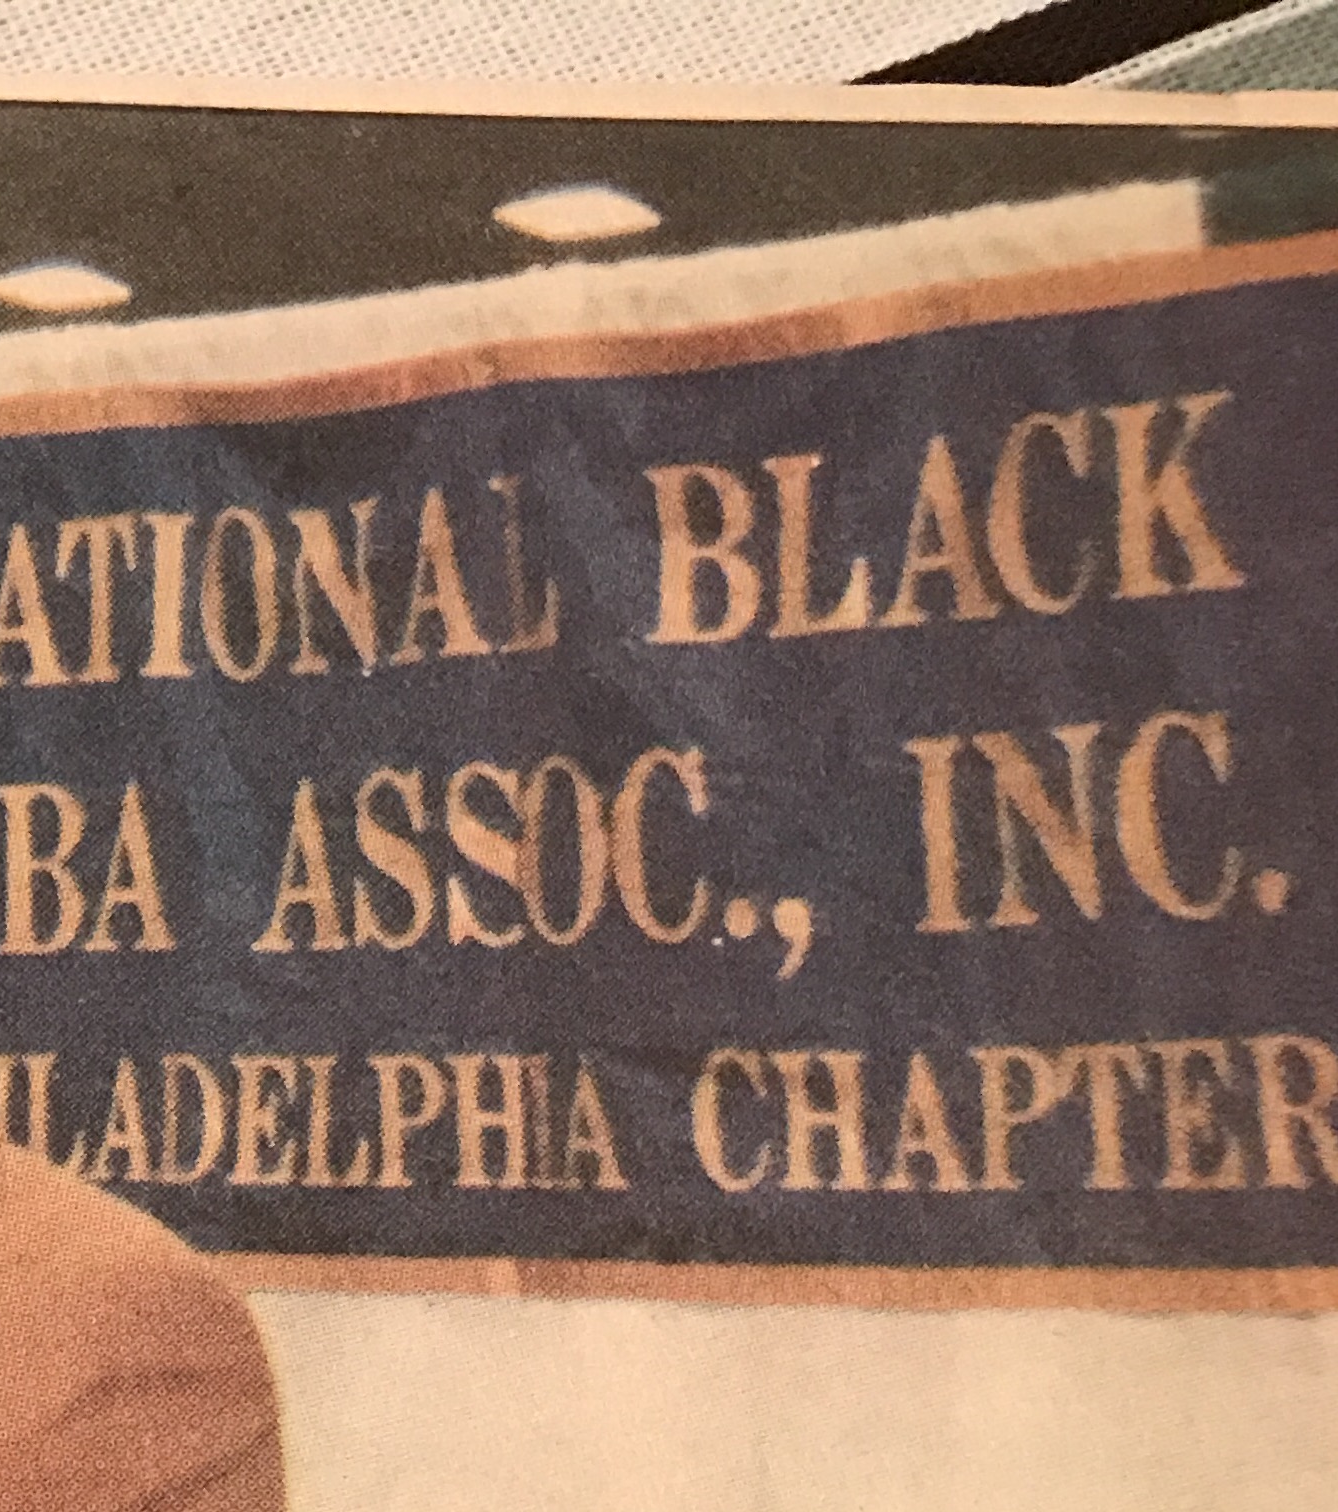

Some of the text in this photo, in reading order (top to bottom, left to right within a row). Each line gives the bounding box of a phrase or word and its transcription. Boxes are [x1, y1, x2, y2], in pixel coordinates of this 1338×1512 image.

[643, 391, 1245, 645] BLACK
[250, 749, 813, 980] ASSOC.,
[903, 710, 1291, 934] INC.
[692, 1033, 1338, 1192] CHAPTER
